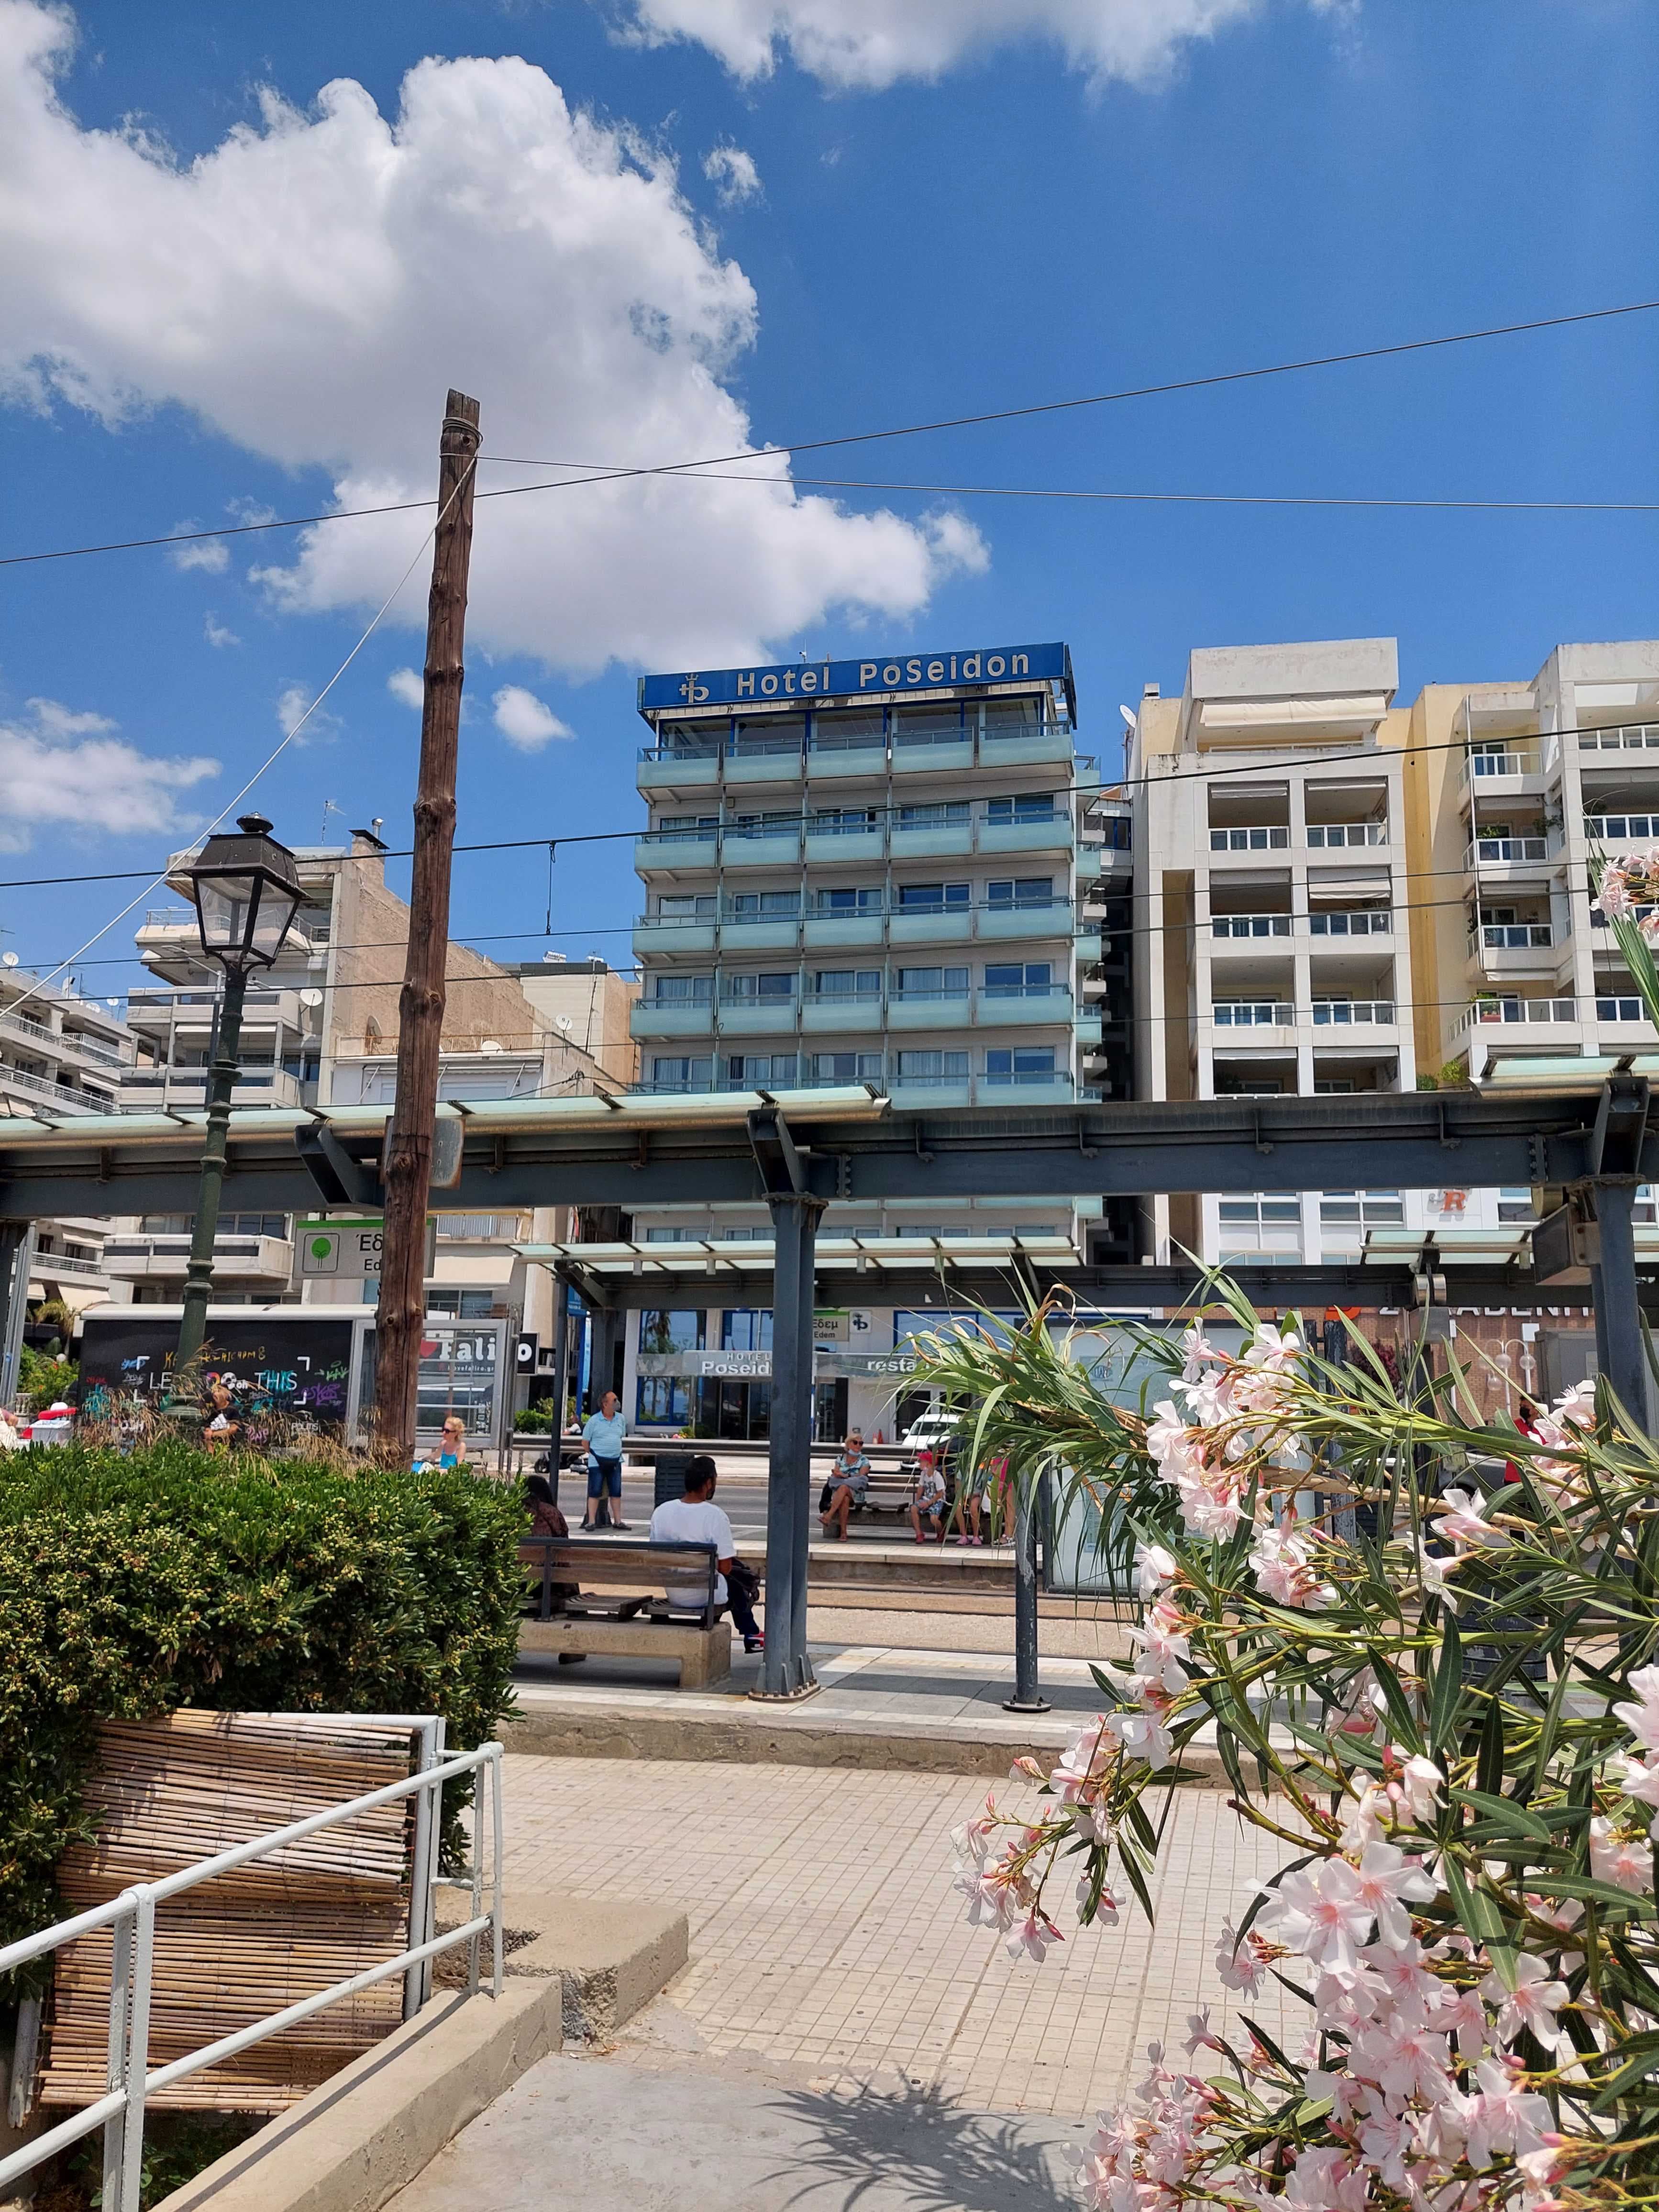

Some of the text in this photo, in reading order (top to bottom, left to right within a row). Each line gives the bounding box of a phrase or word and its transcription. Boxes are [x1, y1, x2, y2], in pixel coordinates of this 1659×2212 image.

[738, 667, 829, 696] Hotel
[355, 1233, 383, 1251] Έδ
[365, 1259, 382, 1271] Ed
[439, 1337, 532, 1361] Falio
[702, 1361, 773, 1374] Poseid
[868, 1358, 916, 1372] resta
[149, 1372, 173, 1390] LE
[254, 1372, 297, 1390] THIS
